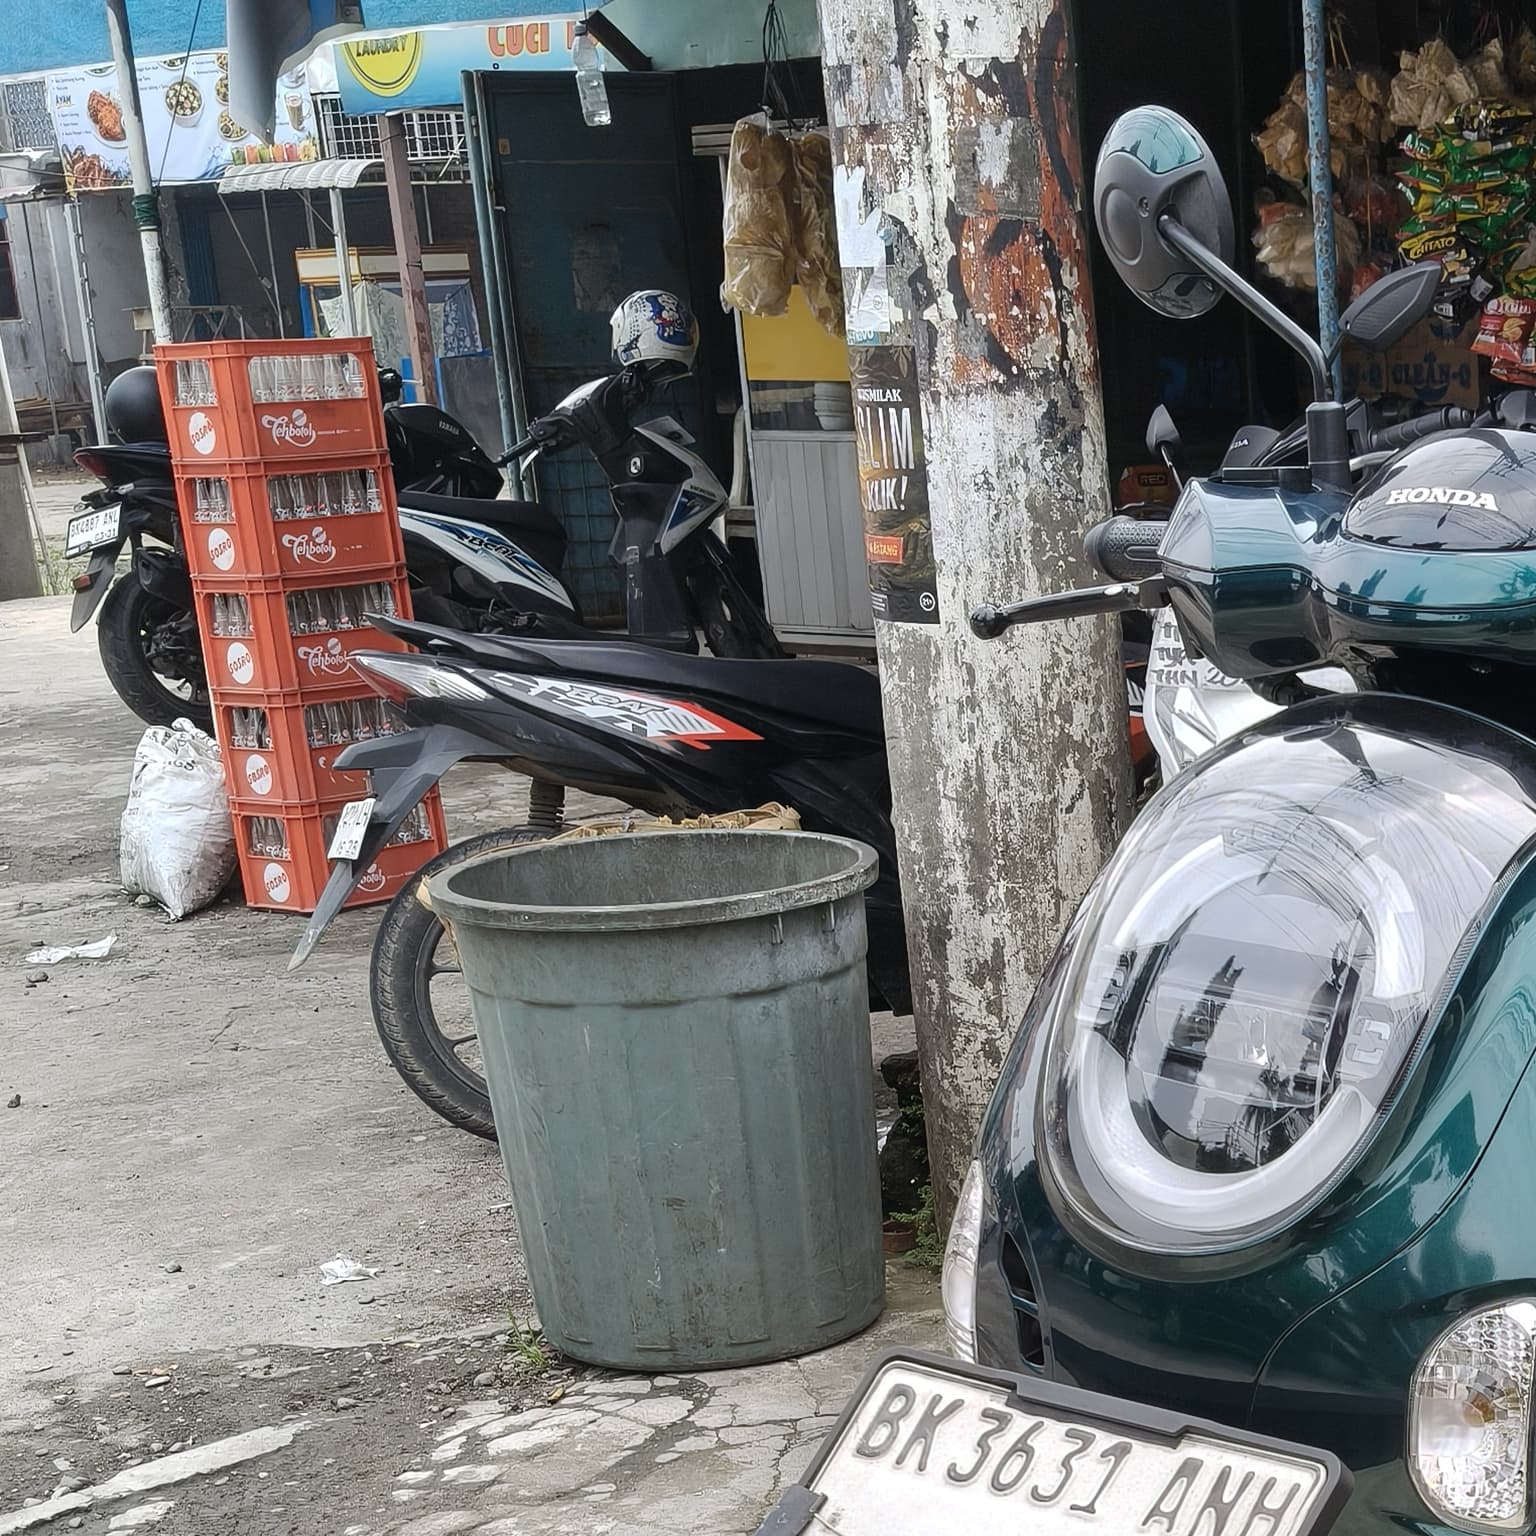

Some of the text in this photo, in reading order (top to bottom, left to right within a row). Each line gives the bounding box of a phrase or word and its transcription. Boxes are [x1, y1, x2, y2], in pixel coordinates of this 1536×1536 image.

[1385, 487, 1499, 512] HONDA
[210, 538, 232, 560] SOSRO
[228, 651, 251, 675] SOSRO
[266, 872, 287, 895] SOSRO
[855, 1383, 965, 1473] BK
[946, 1407, 1133, 1515] 3631
